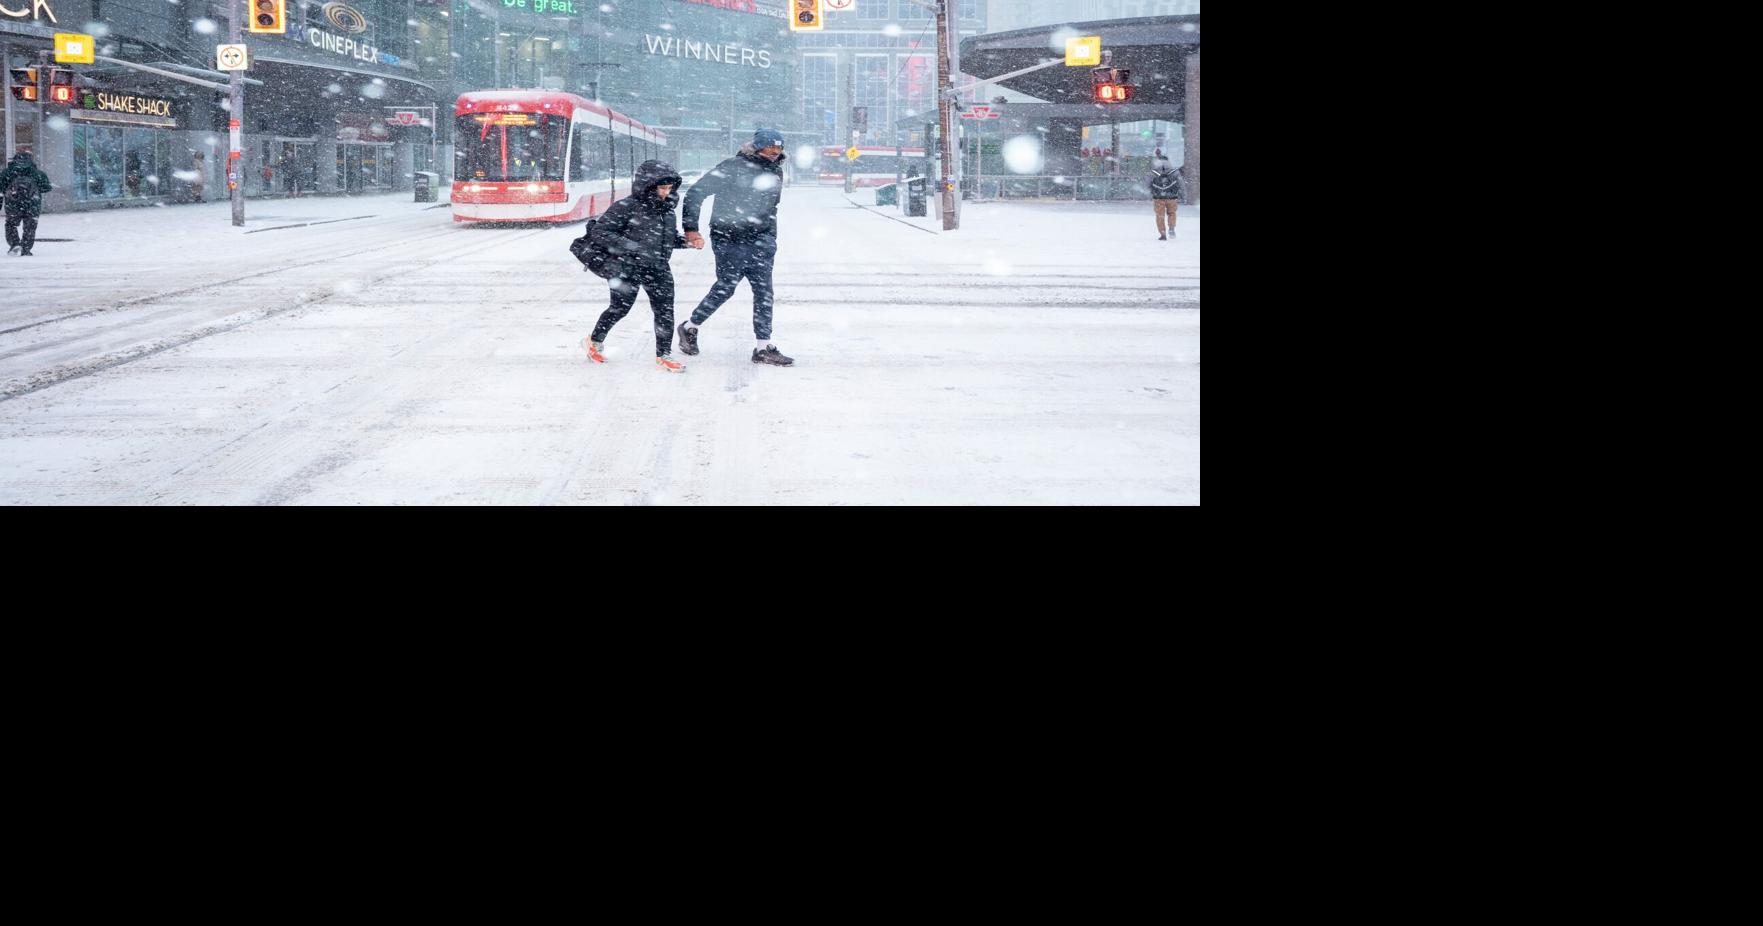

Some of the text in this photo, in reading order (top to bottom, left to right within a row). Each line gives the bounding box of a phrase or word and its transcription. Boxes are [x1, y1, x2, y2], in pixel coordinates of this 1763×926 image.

[310, 27, 378, 64] CINEPLEX
[645, 33, 771, 68] WINNERS
[97, 92, 171, 117] SHAKE SHACK
